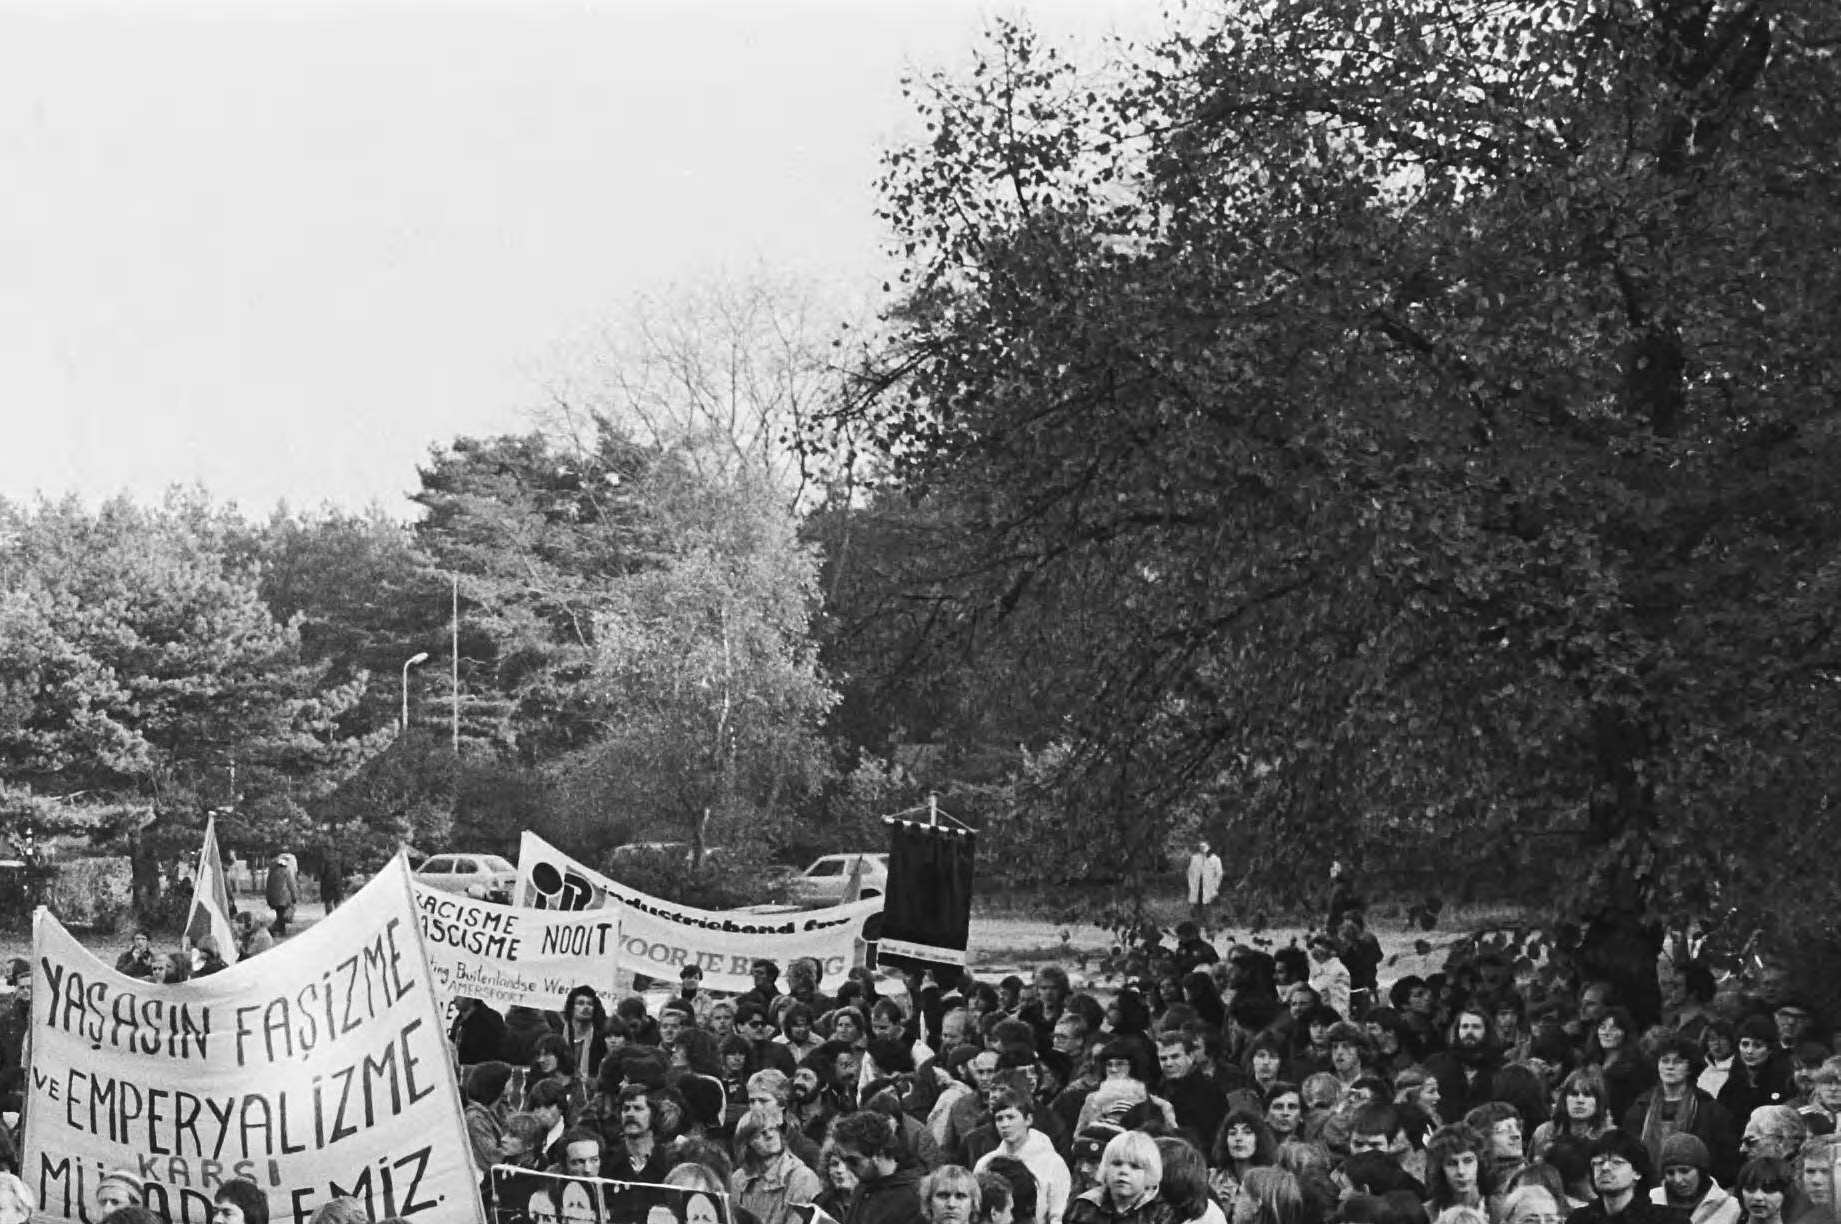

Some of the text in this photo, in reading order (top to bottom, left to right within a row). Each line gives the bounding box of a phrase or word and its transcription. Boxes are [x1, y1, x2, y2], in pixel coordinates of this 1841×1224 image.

[41, 917, 415, 1067] YAŞASIN FAŞİZME
[541, 923, 612, 956] NOOIT
[66, 1018, 436, 1160] EMPERYALİZME
